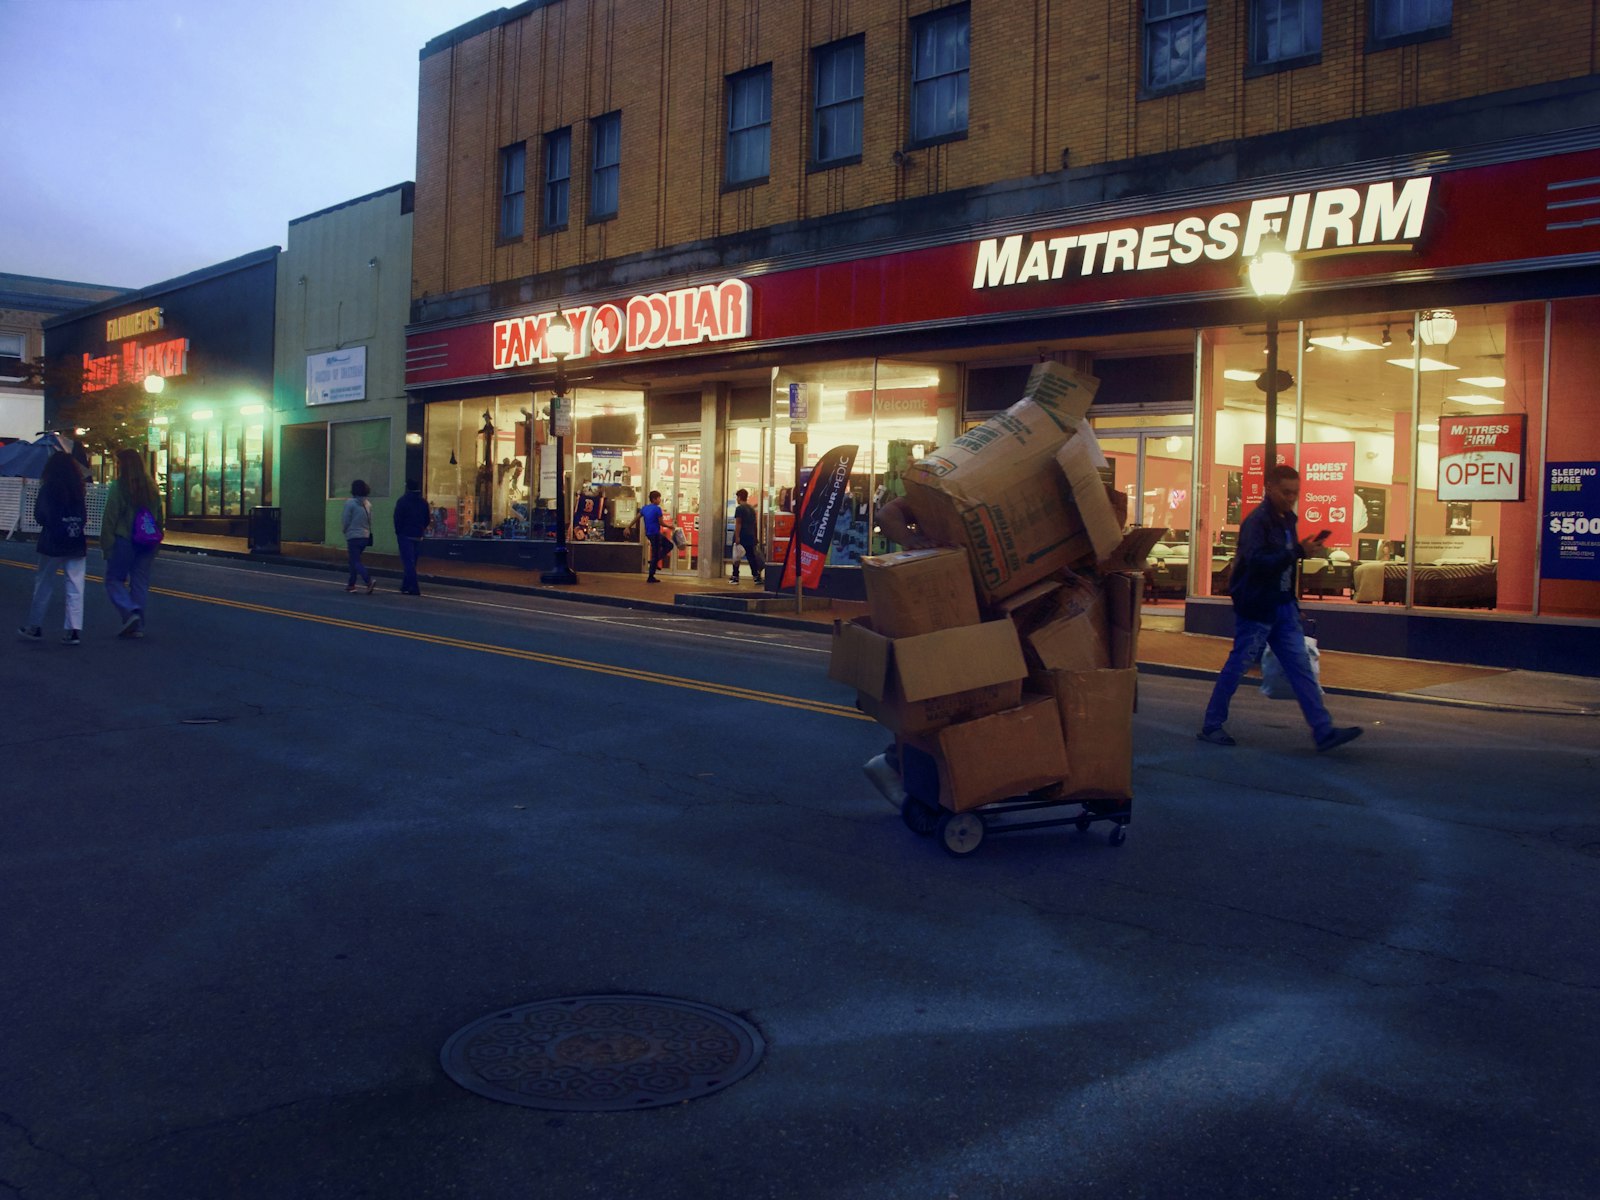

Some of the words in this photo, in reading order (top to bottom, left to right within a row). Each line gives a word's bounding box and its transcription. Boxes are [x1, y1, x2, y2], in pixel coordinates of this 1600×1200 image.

[973, 212, 1239, 290] MATTRESS
[1241, 177, 1432, 257] FIRM
[494, 307, 592, 369] FAMY
[625, 279, 749, 352] DOLLAR
[876, 398, 929, 411] Welcome
[1451, 425, 1509, 435] MATTRESS
[1464, 434, 1497, 445] FIRM
[1306, 463, 1347, 472] LOWEST
[1551, 468, 1597, 476] SLEEPING
[1306, 472, 1344, 481] PRICES
[1446, 463, 1513, 485] OPEN
[1551, 476, 1581, 484] SPREE
[1551, 484, 1582, 492] EVENT
[814, 456, 849, 544] TEMPUR-PEDIC
[1550, 518, 1600, 534] $500
